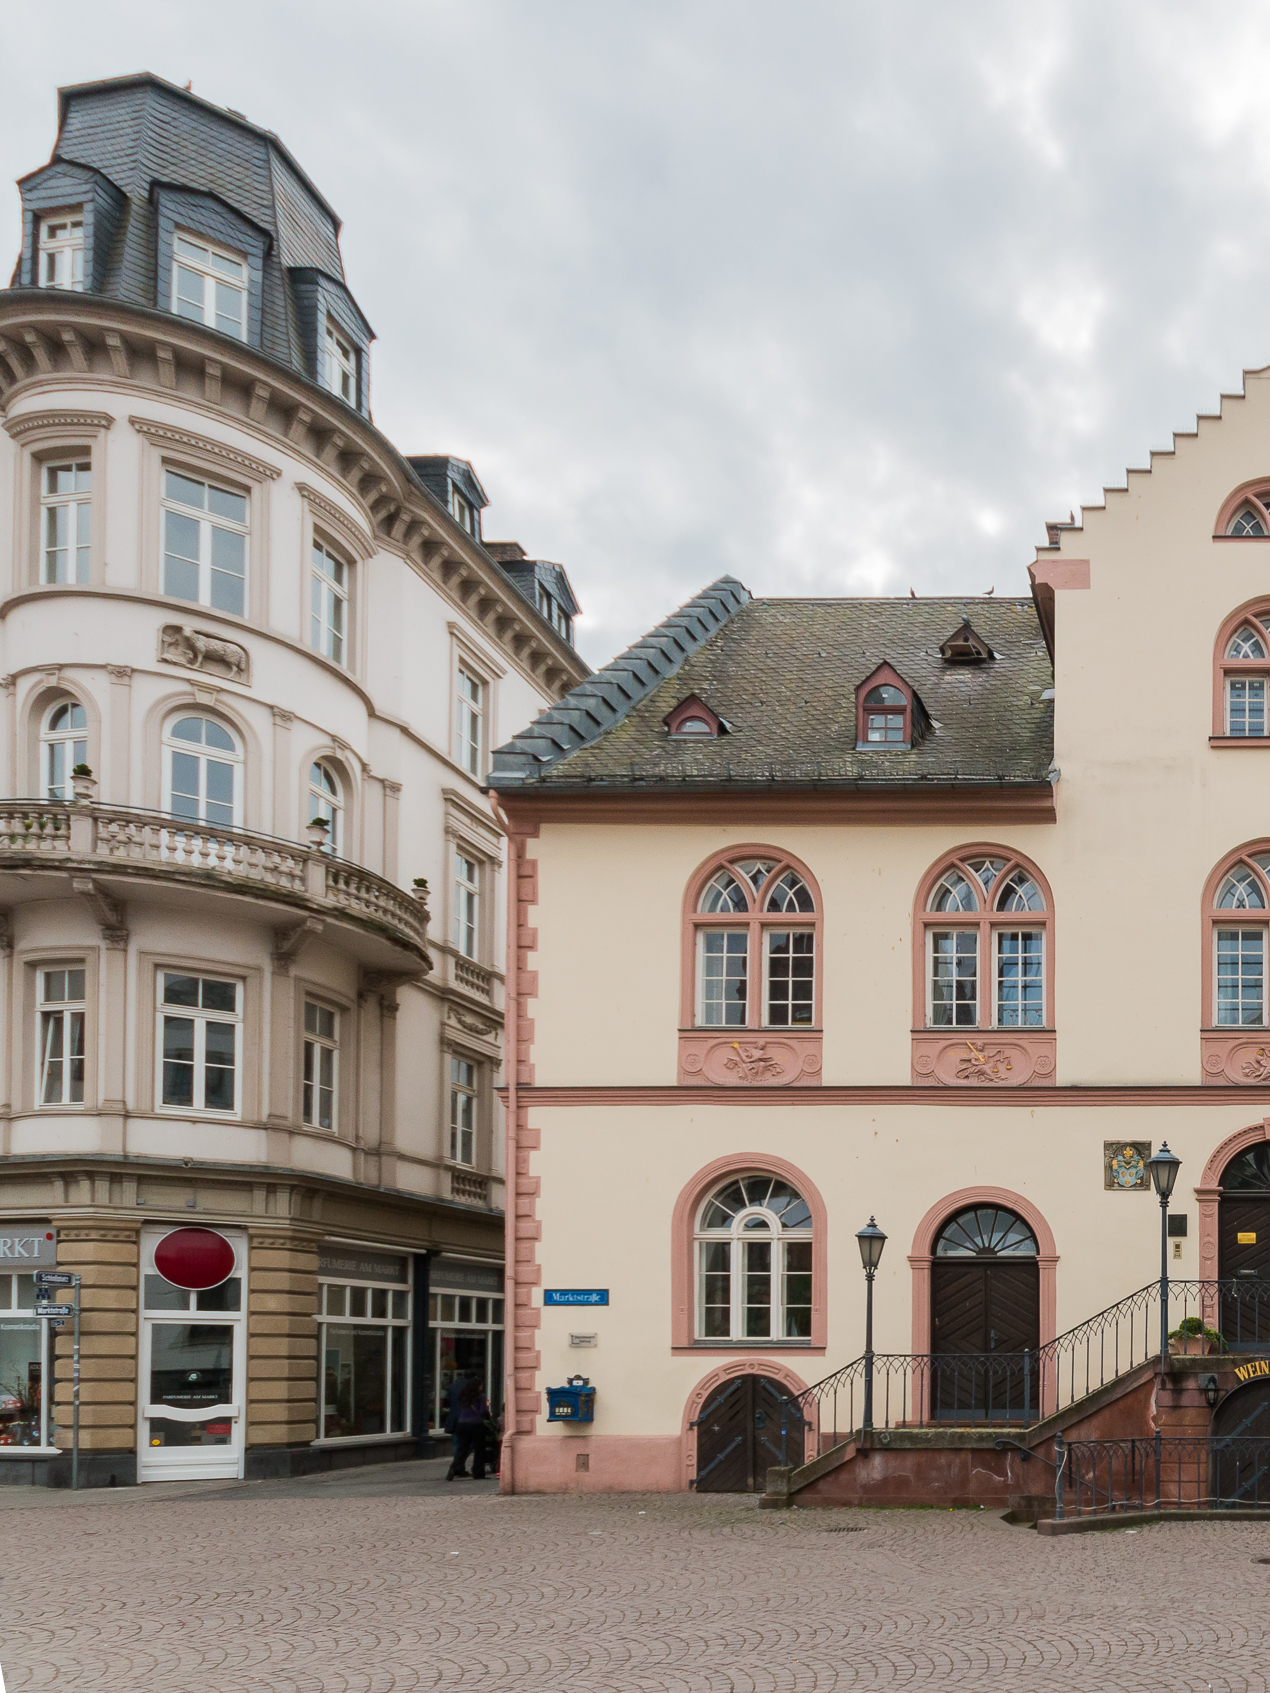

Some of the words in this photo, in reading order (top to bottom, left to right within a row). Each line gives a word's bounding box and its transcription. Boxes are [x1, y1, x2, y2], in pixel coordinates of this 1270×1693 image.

[0, 1238, 43, 1258] RKT
[359, 1262, 372, 1273] AM
[374, 1264, 400, 1275] MARKT
[552, 1293, 601, 1303] Marktstraße
